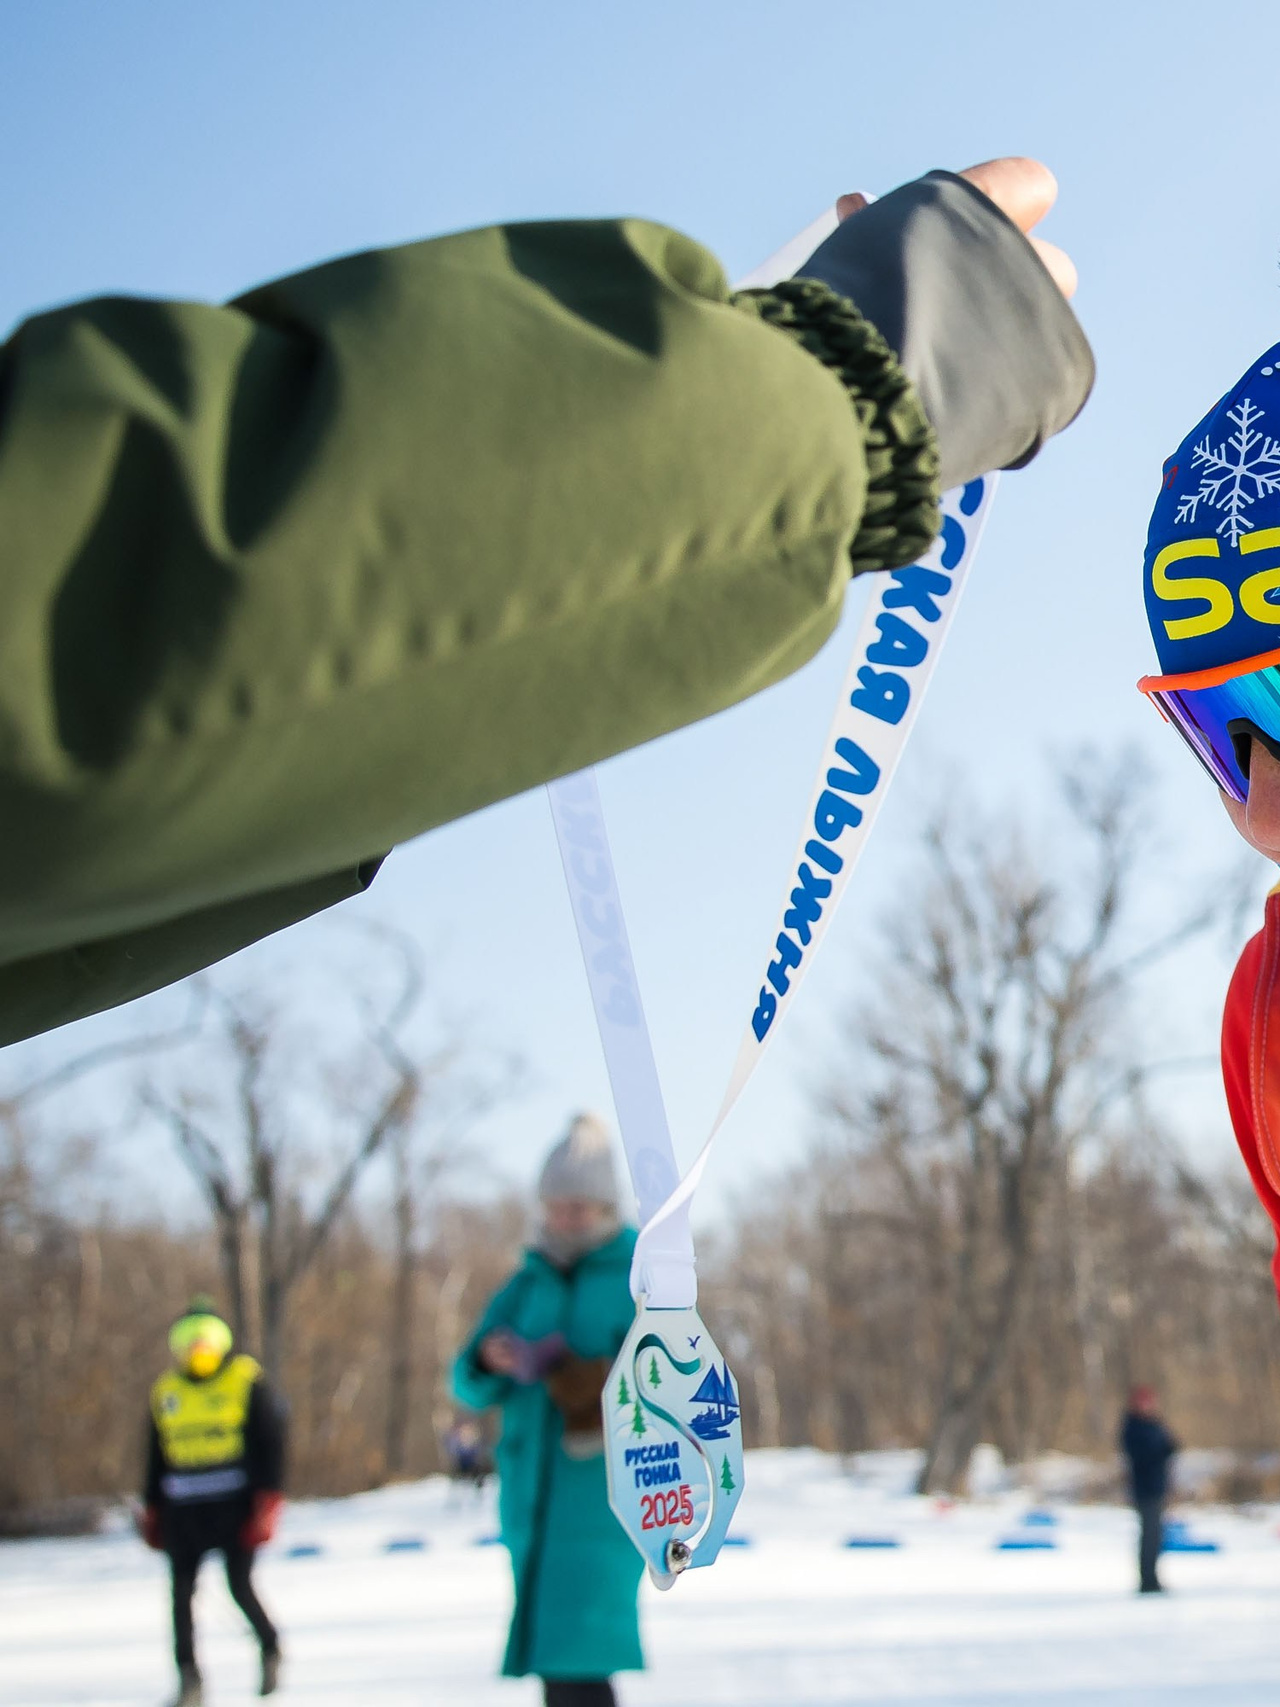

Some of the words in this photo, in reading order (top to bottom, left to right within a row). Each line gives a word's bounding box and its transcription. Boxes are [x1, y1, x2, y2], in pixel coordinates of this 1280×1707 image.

[751, 737, 881, 1043] ЛЫЖНЯ
[625, 1441, 680, 1466] РУССКАЯ
[635, 1462, 682, 1488] ГОНКА
[641, 1484, 694, 1530] 2025
